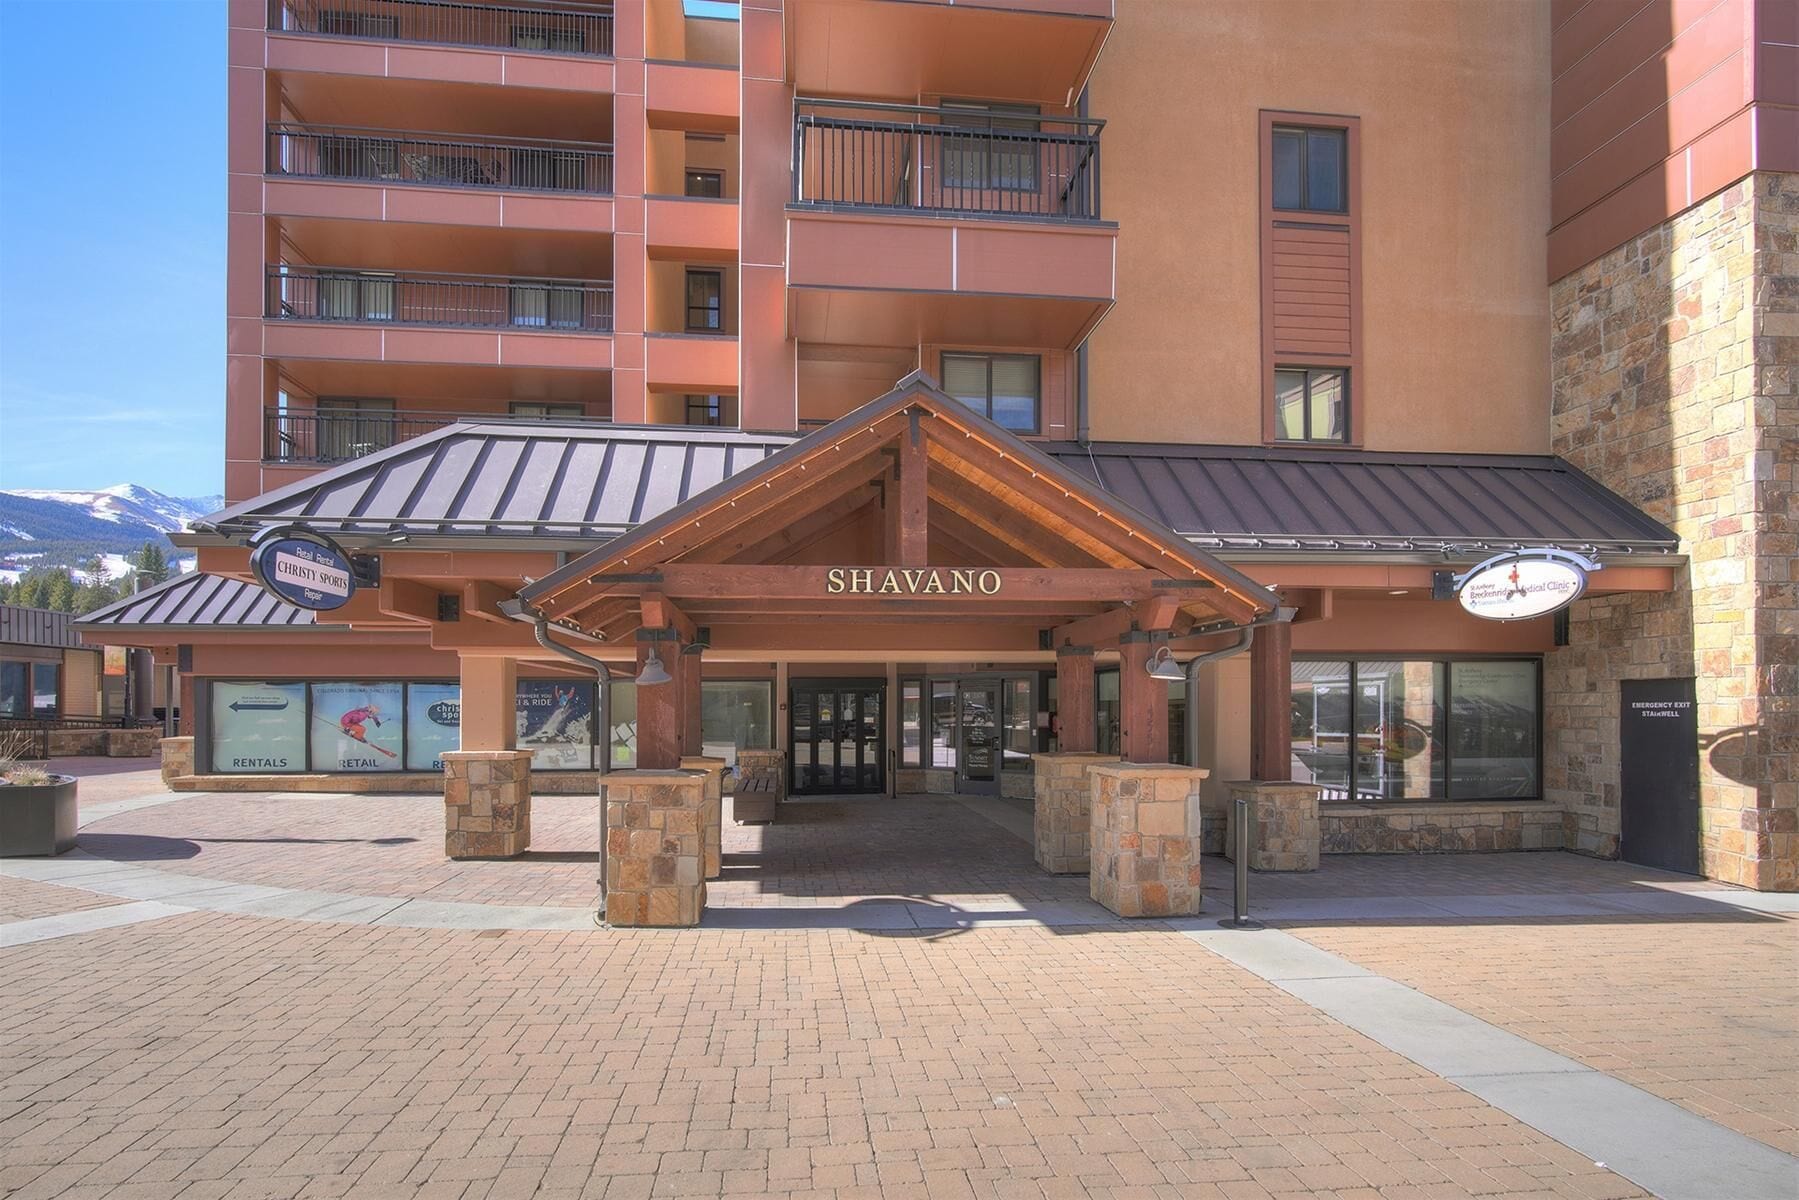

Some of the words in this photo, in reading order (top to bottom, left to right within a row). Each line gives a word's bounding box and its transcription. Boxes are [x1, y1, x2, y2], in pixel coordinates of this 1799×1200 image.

[296, 547, 313, 560] Retail
[316, 553, 334, 567] Rental
[277, 560, 318, 580] CHRISTY
[319, 571, 348, 589] SPORTS
[827, 568, 1002, 595] SHAVANO
[304, 588, 323, 601] Repair
[1470, 587, 1510, 599] Breckenrid
[1546, 581, 1570, 591] Clinic
[436, 704, 460, 713] chris
[442, 712, 459, 720] spo
[233, 758, 287, 768] RENTALS
[338, 759, 379, 768] RETAIL
